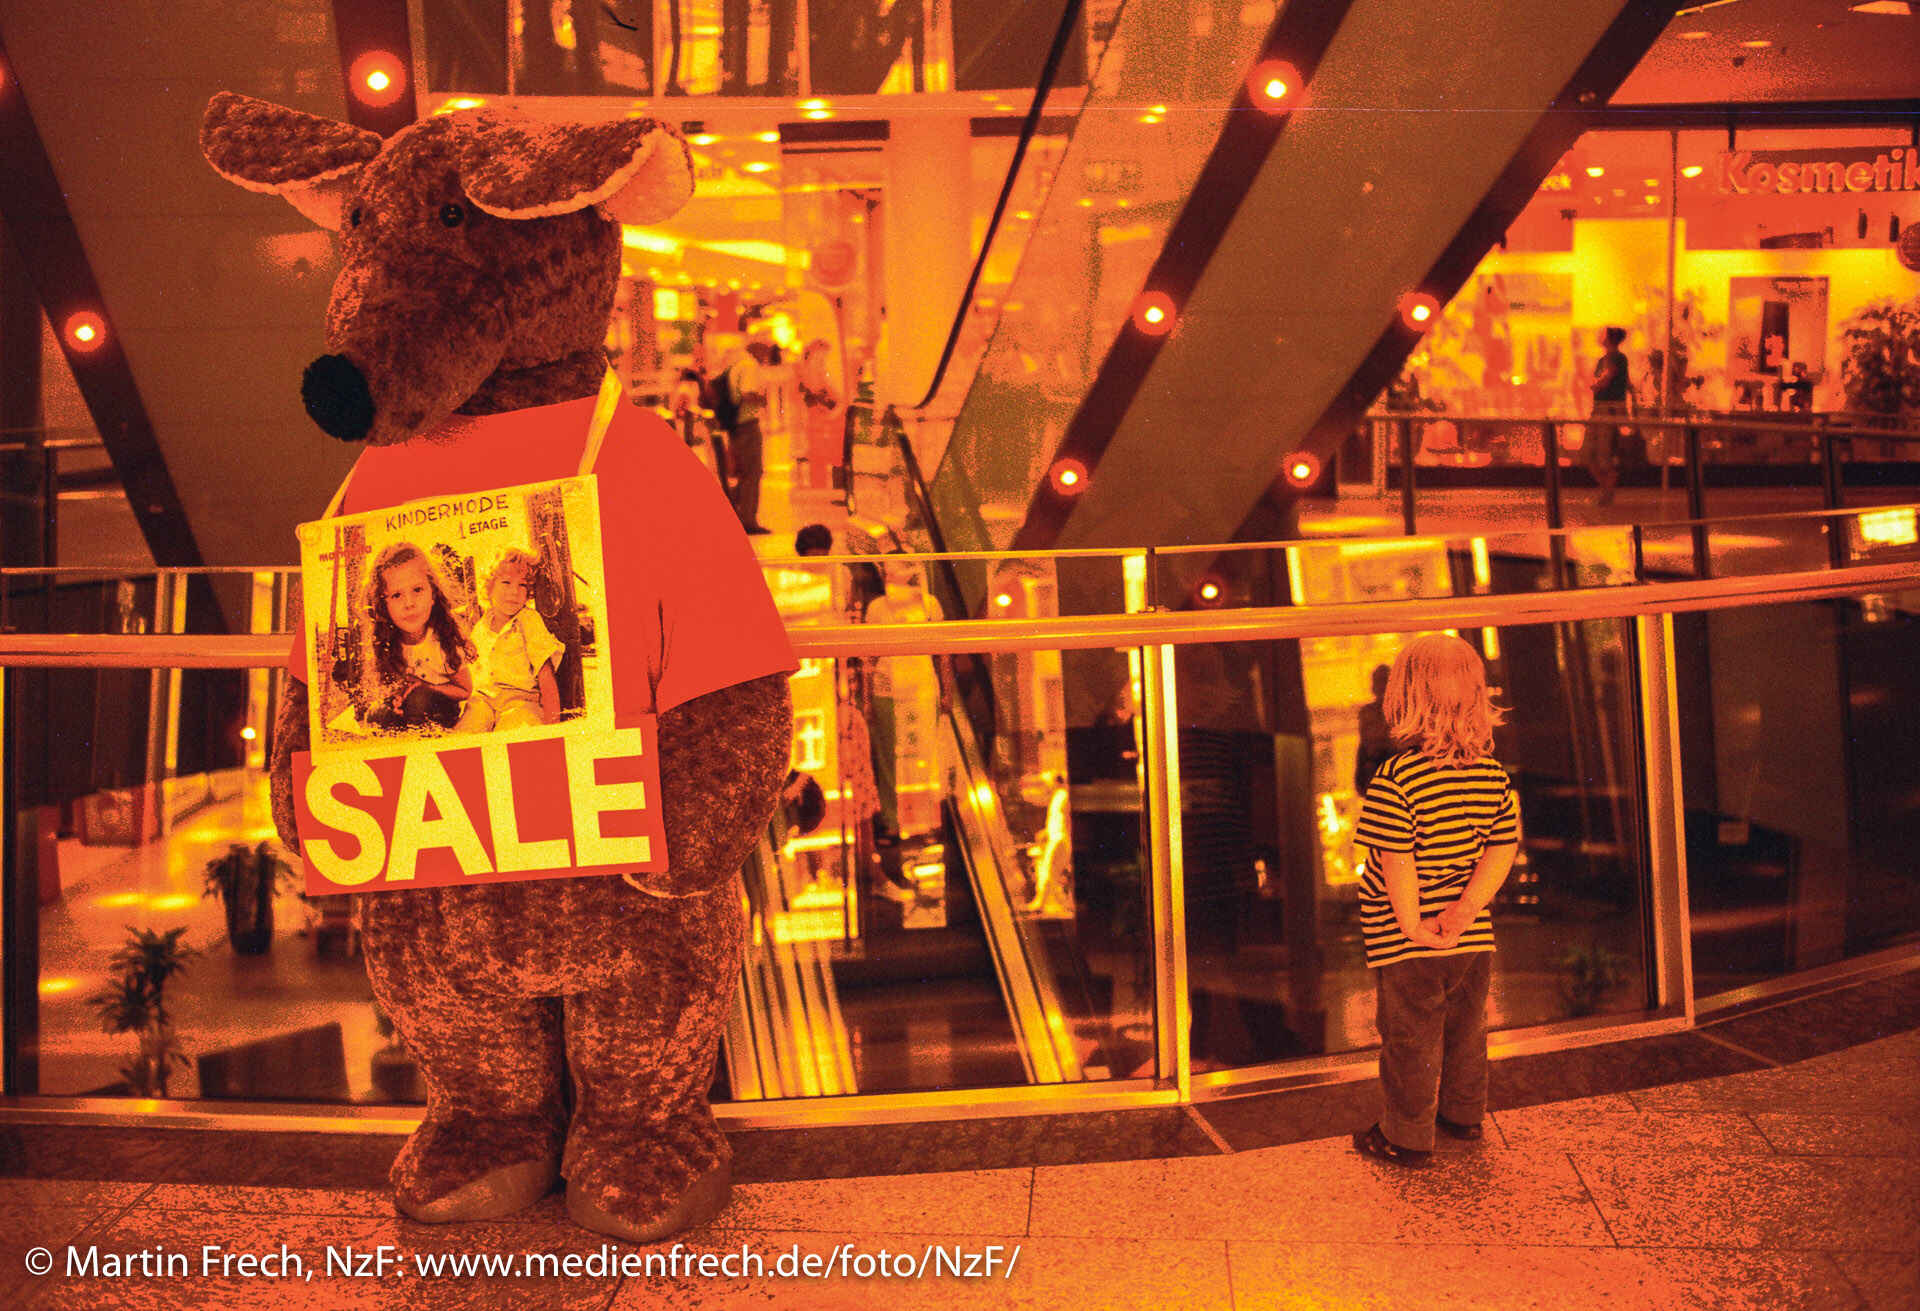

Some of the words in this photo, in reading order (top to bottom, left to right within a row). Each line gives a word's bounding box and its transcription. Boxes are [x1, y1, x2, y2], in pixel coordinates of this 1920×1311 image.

[1718, 147, 1920, 194] Kosmetik
[385, 493, 509, 533] KINDERMODE
[468, 516, 509, 535] ETAGE
[302, 727, 652, 886] SALE
